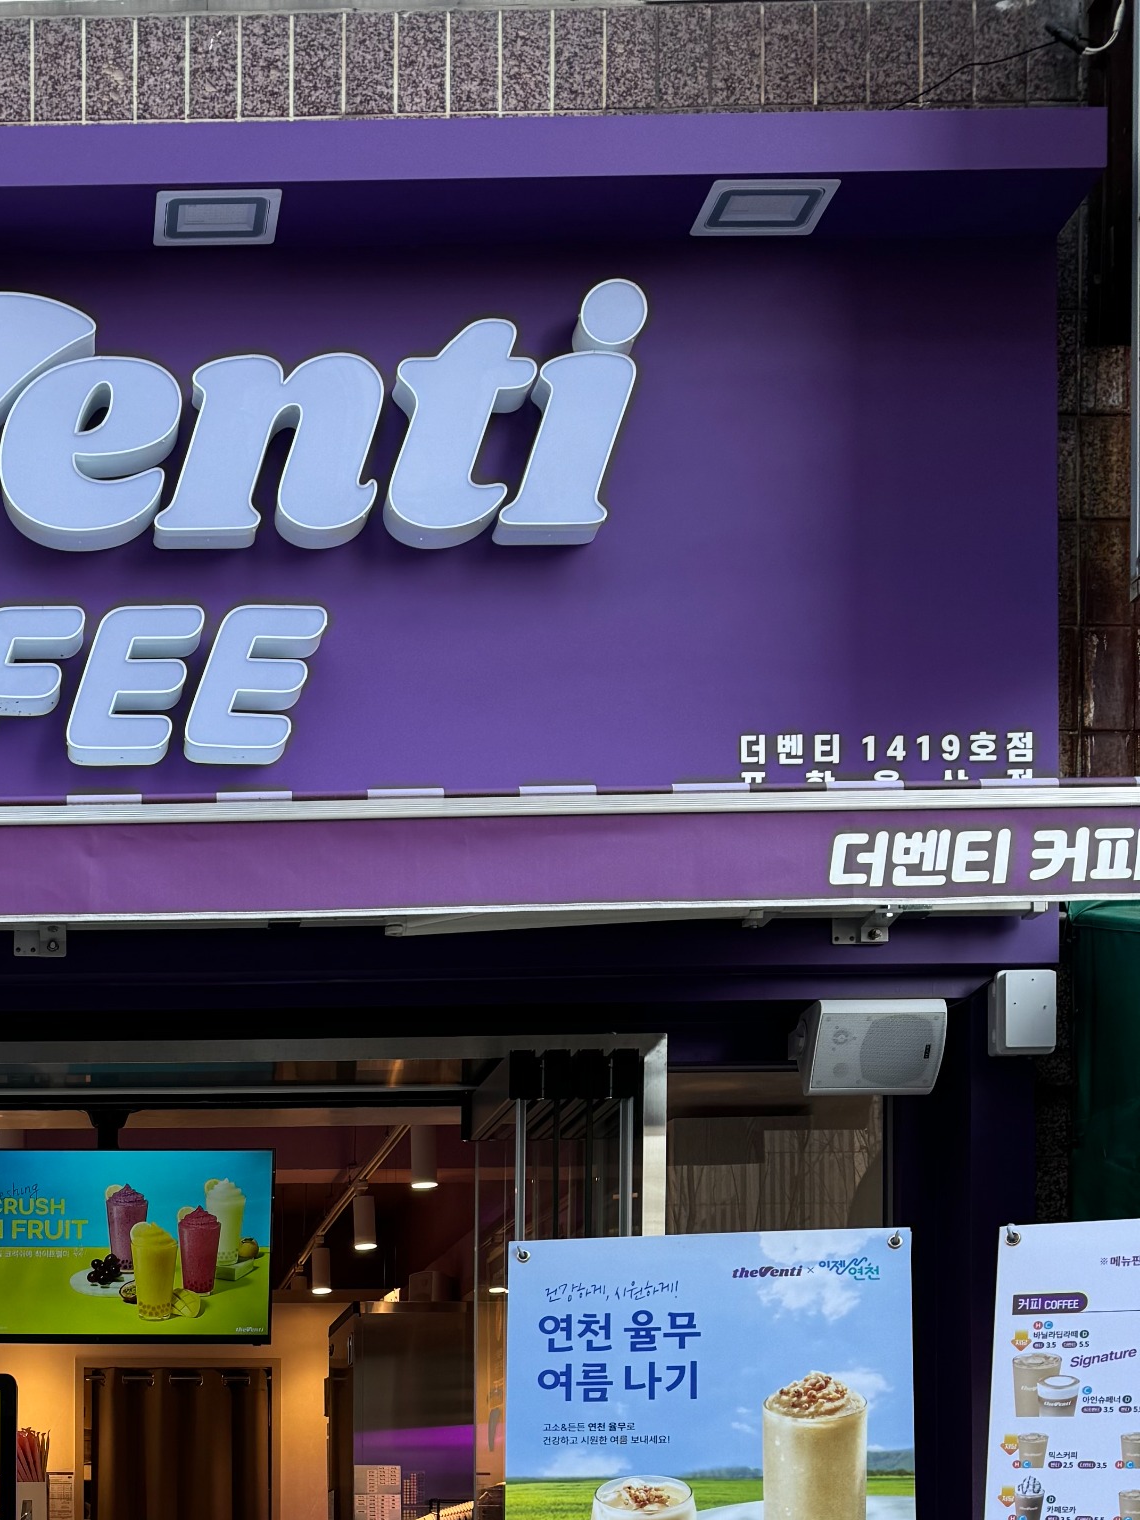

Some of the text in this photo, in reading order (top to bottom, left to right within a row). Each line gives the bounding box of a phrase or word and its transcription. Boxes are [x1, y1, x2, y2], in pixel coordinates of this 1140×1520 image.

[739, 731, 1034, 765] 더벤티 1419호점
[828, 826, 1140, 887] 더벤티 커피
[11, 1219, 89, 1240] FRUIT
[732, 1264, 803, 1279] theVenti
[545, 1280, 679, 1303] 건강하게, 시원하게!
[1017, 1297, 1080, 1310] 커피 COFFEE
[538, 1309, 702, 1353] 연천 율무
[1069, 1348, 1138, 1368] Signature
[537, 1360, 698, 1403] 여름 나기
[543, 1421, 636, 1432] 고소&든든 연천 율무로
[542, 1434, 671, 1445] 건강하고 시원한 여름 보내세요!
[1048, 1451, 1078, 1460] 믹스커피
[1046, 1505, 1077, 1515] 카페모카
